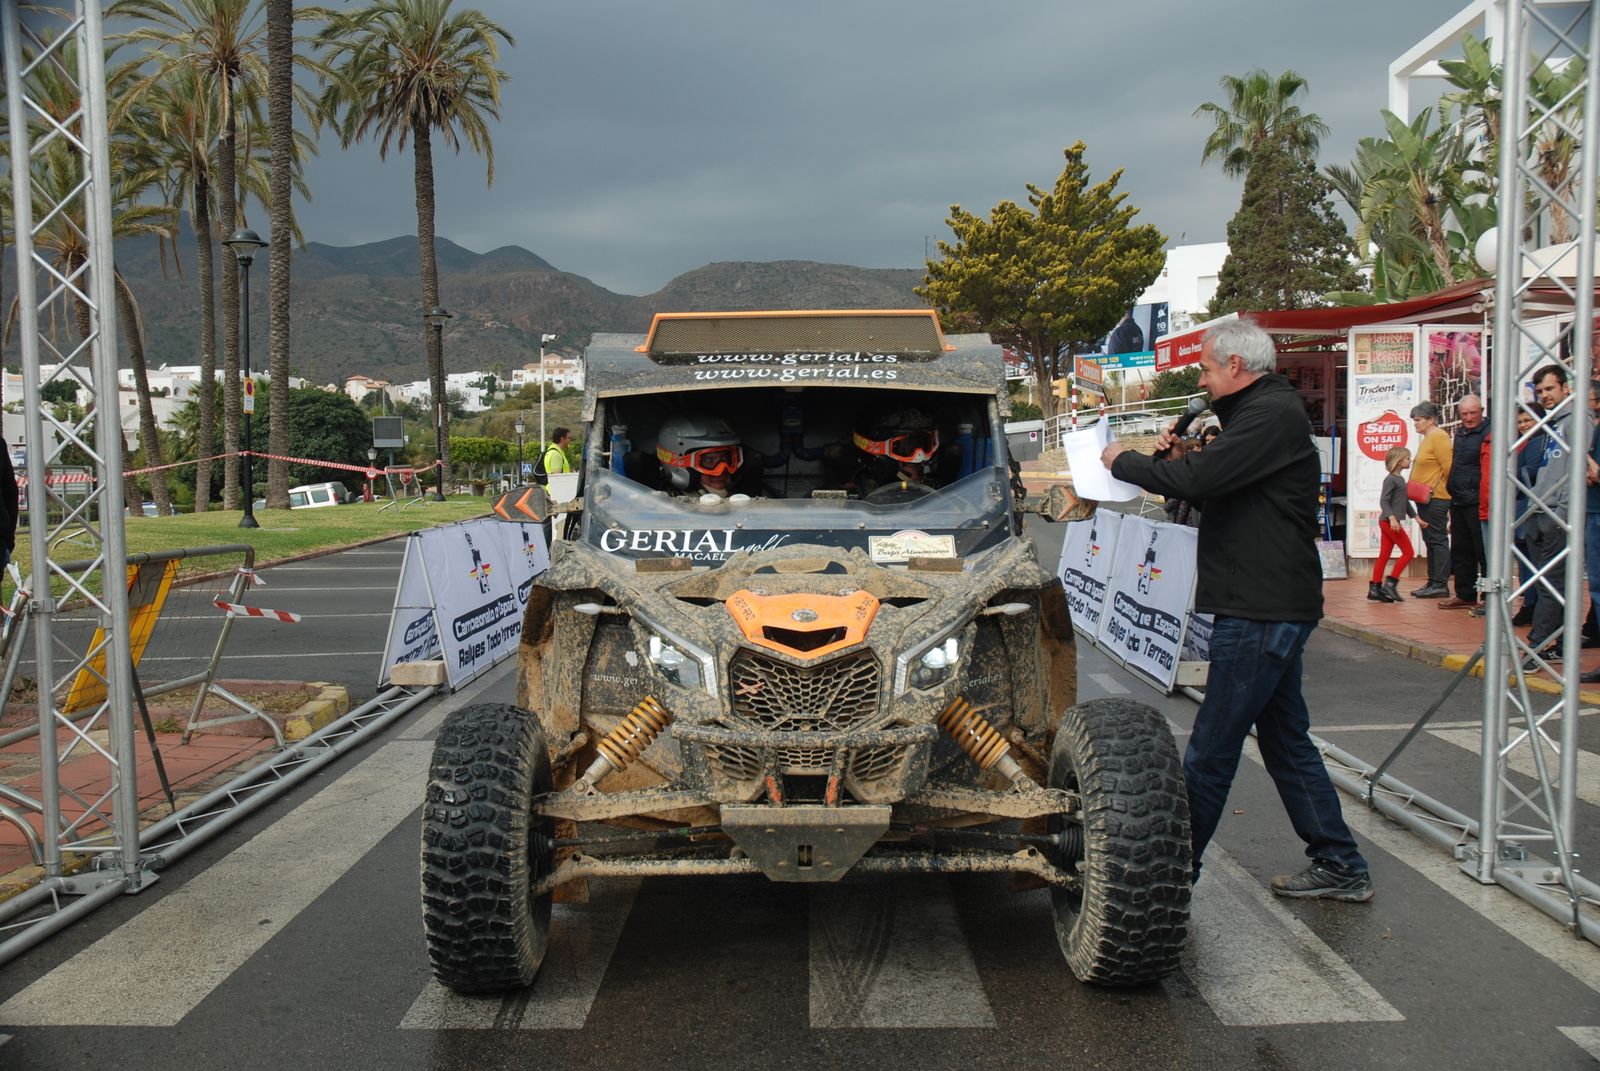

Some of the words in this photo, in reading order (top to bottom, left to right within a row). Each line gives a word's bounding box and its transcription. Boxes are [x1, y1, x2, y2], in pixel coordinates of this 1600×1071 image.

[697, 351, 898, 365] www.gerial.es
[694, 364, 898, 382] www.gerial.es
[1360, 384, 1396, 396] Trident
[1365, 422, 1400, 433] Sun
[1363, 435, 1379, 443] ON
[1380, 435, 1402, 443] SALE
[600, 529, 744, 552] GERIAL
[673, 552, 727, 561] MACAEL
[458, 641, 485, 669] Rallyes
[1143, 636, 1174, 671] Terreno
